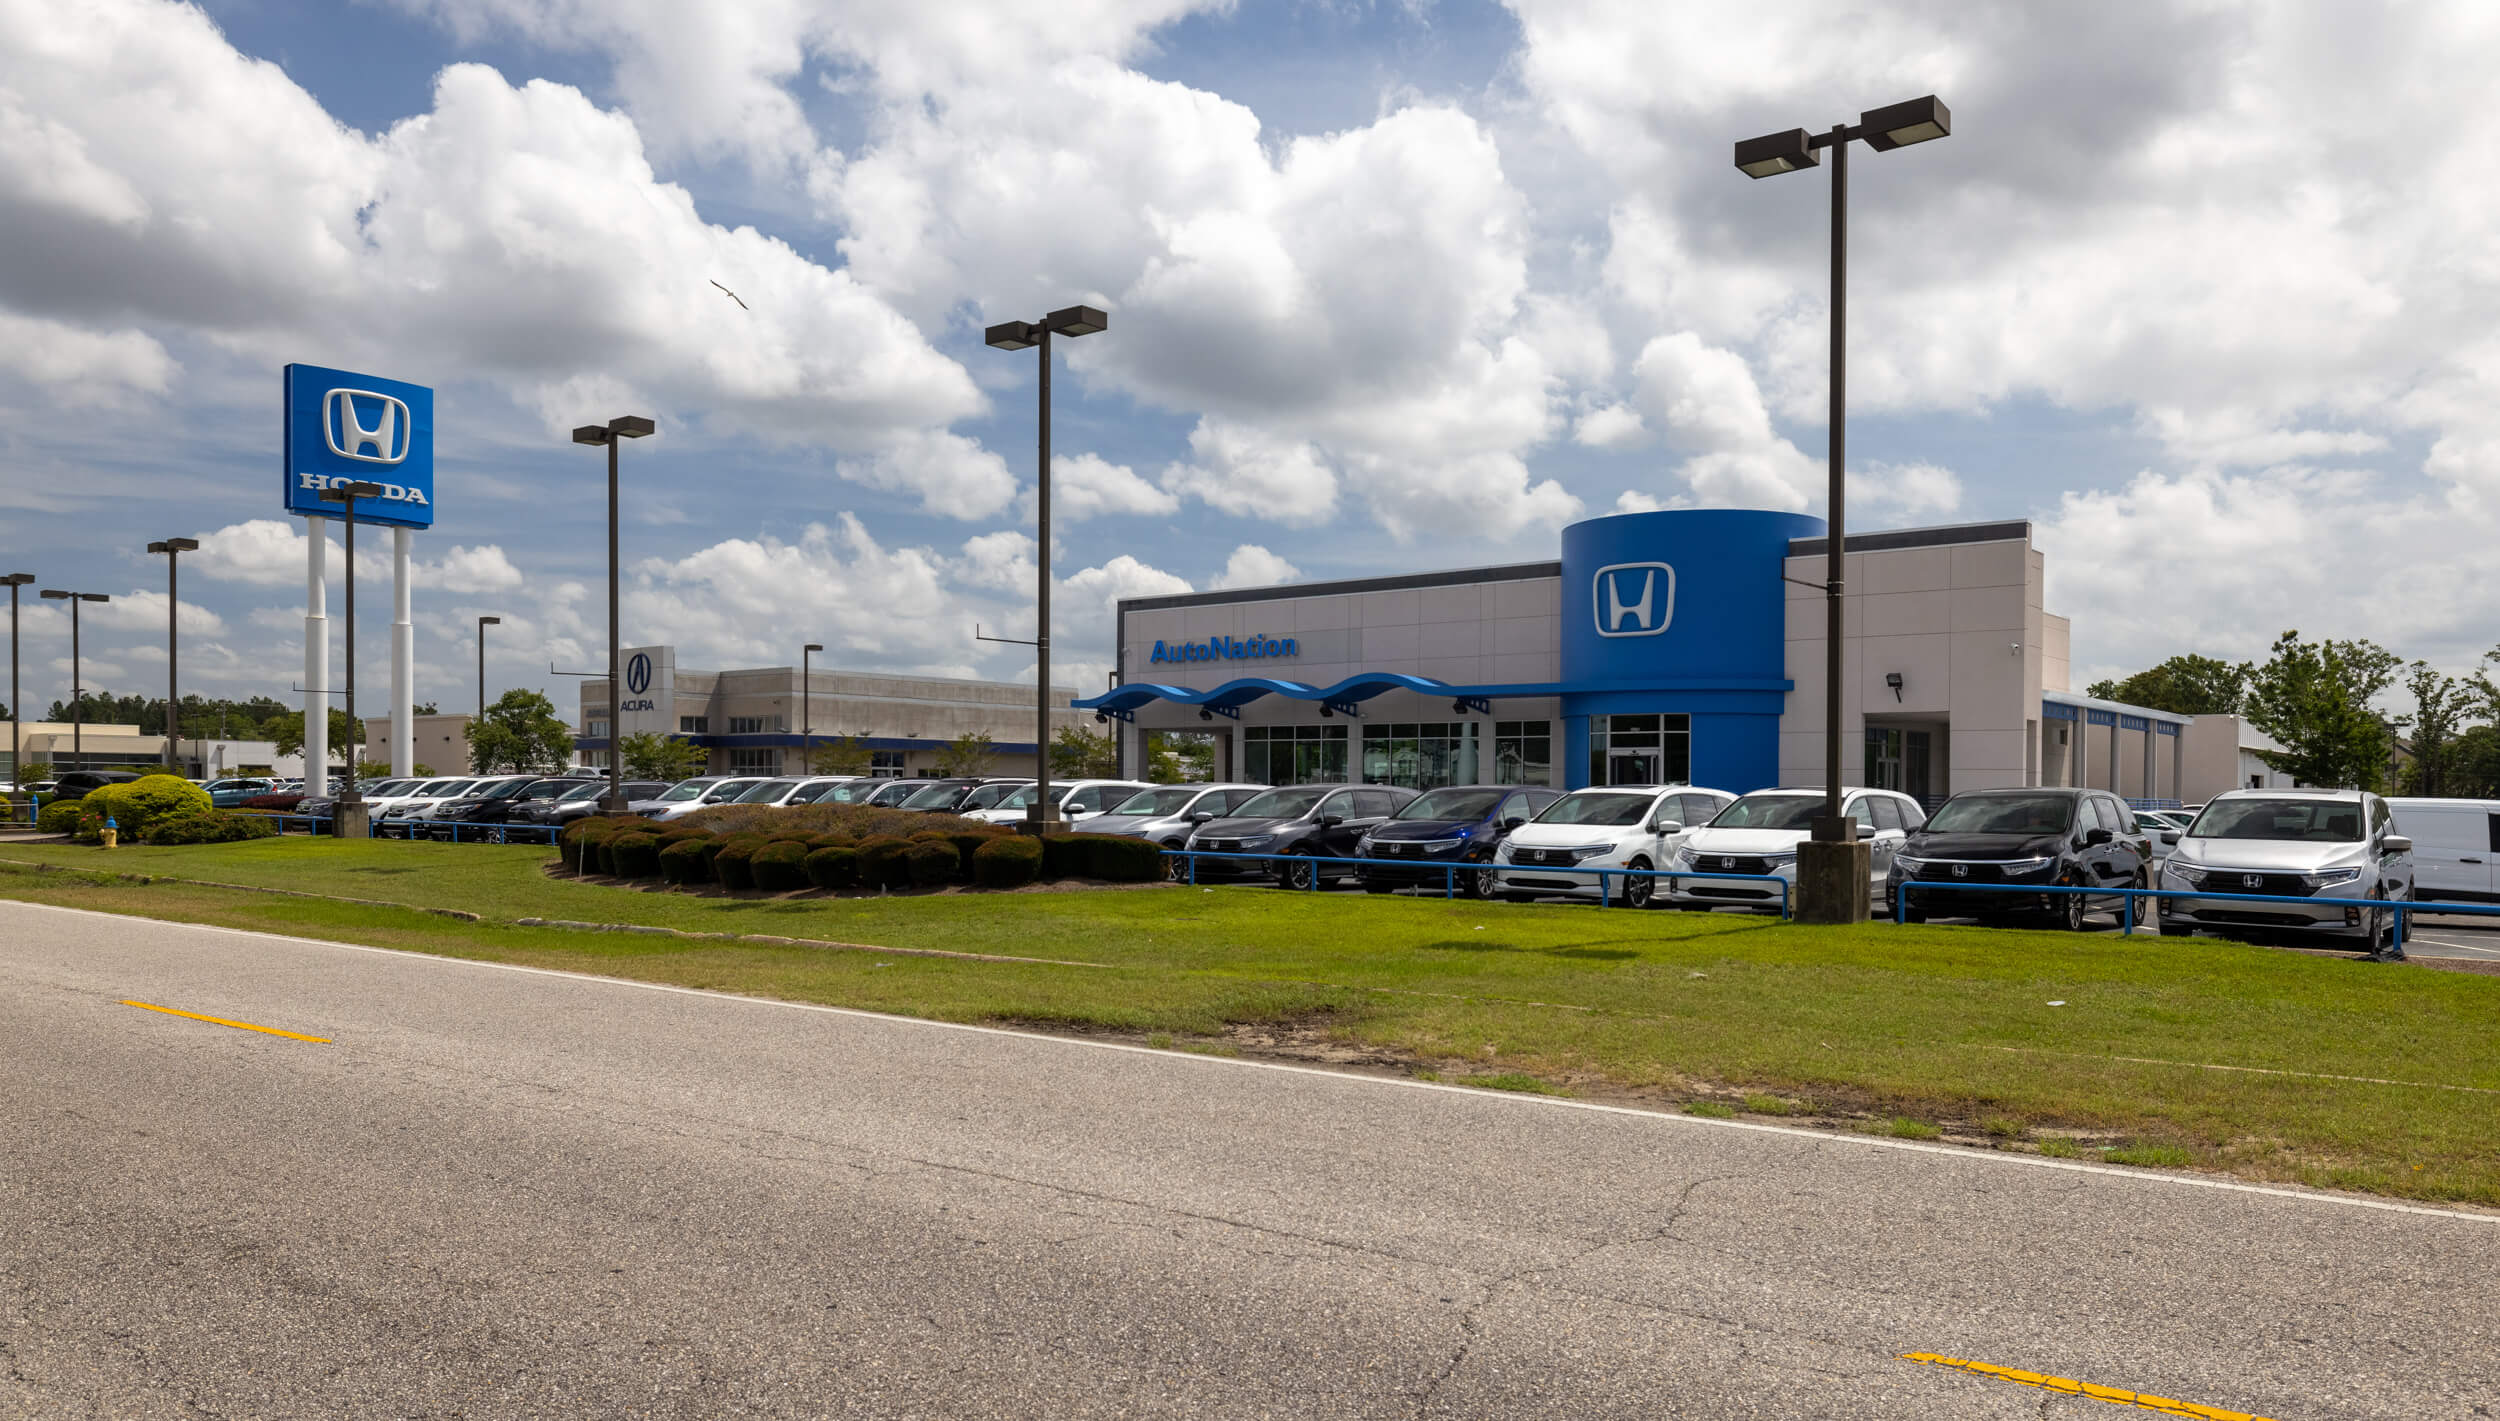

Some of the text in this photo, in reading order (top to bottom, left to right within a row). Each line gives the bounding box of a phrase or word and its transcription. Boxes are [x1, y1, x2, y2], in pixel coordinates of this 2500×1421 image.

[299, 472, 430, 505] HODA
[1150, 633, 1296, 663] AutoNation
[620, 700, 655, 712] ACURA
